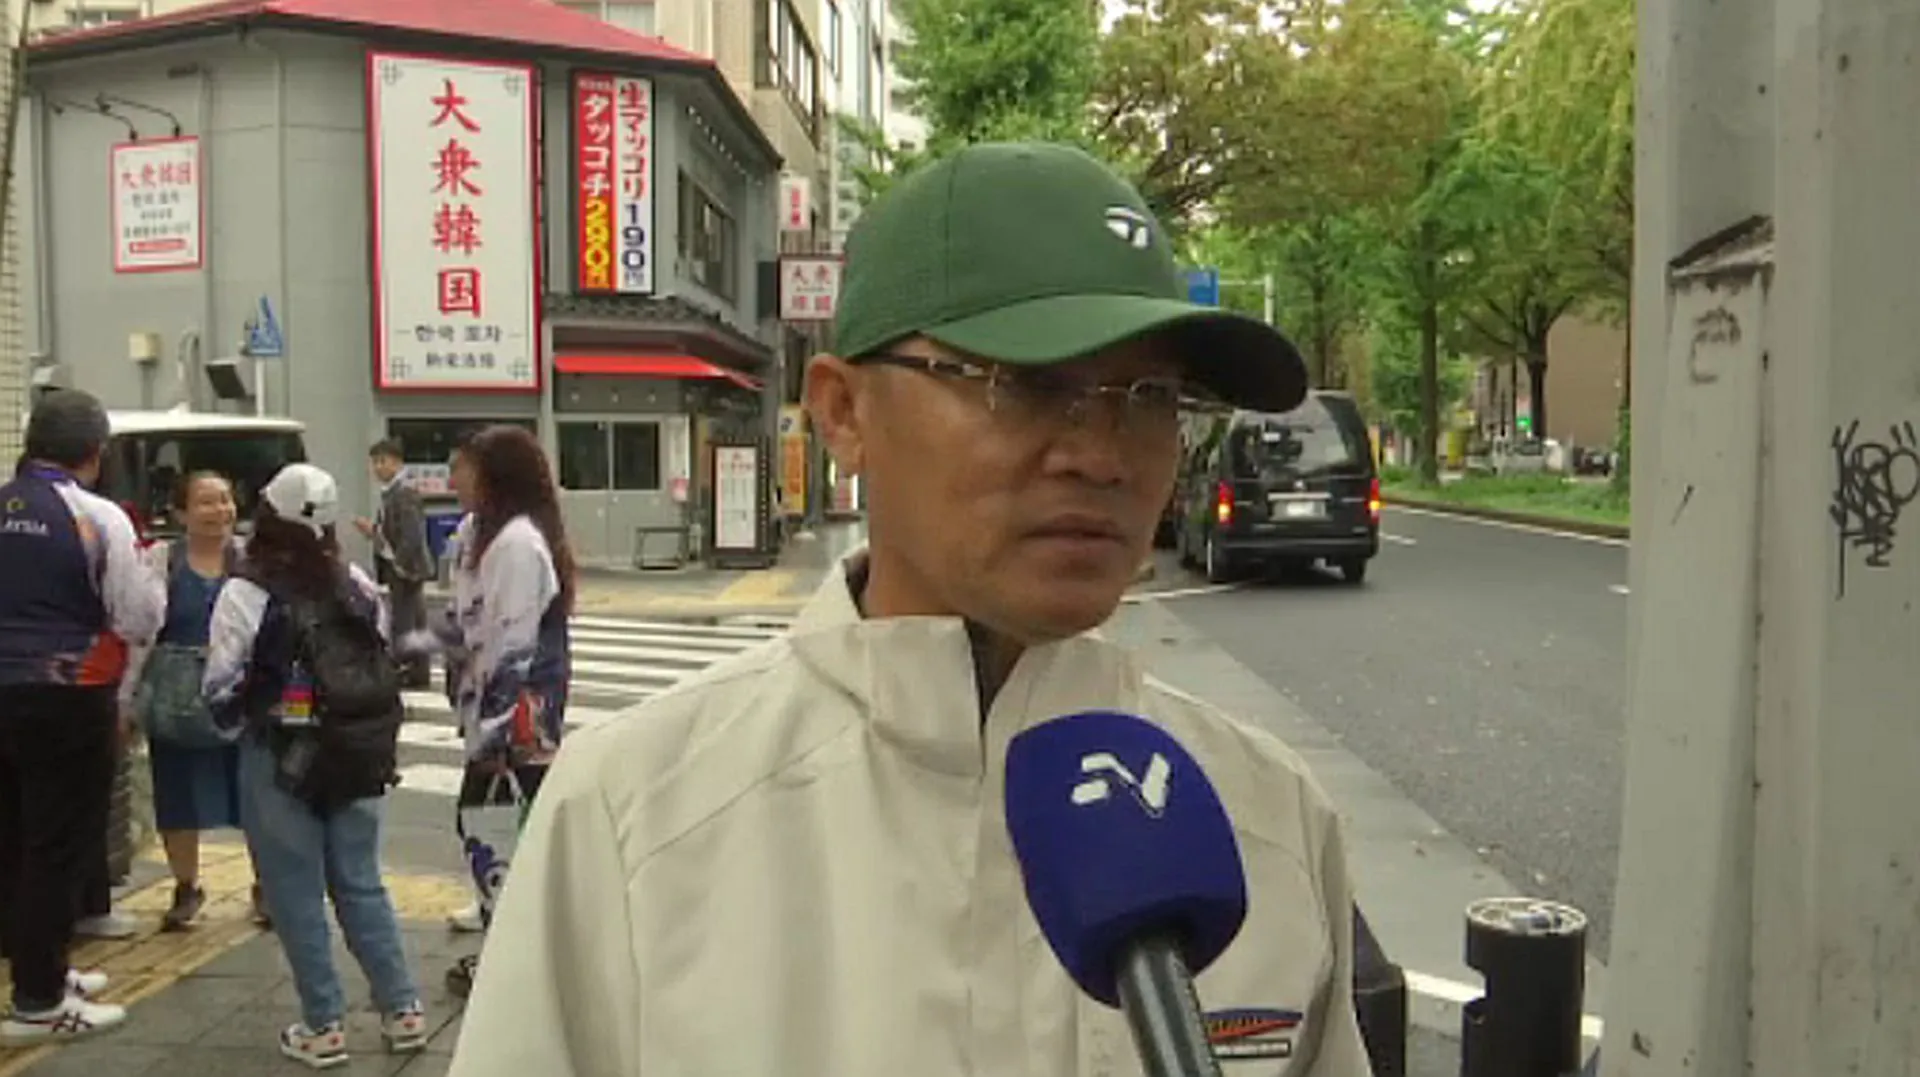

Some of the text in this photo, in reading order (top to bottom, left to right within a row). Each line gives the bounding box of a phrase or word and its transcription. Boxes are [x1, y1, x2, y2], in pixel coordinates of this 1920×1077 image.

[429, 77, 481, 318] 大衆韓国
[0, 517, 49, 537] AYSIA
